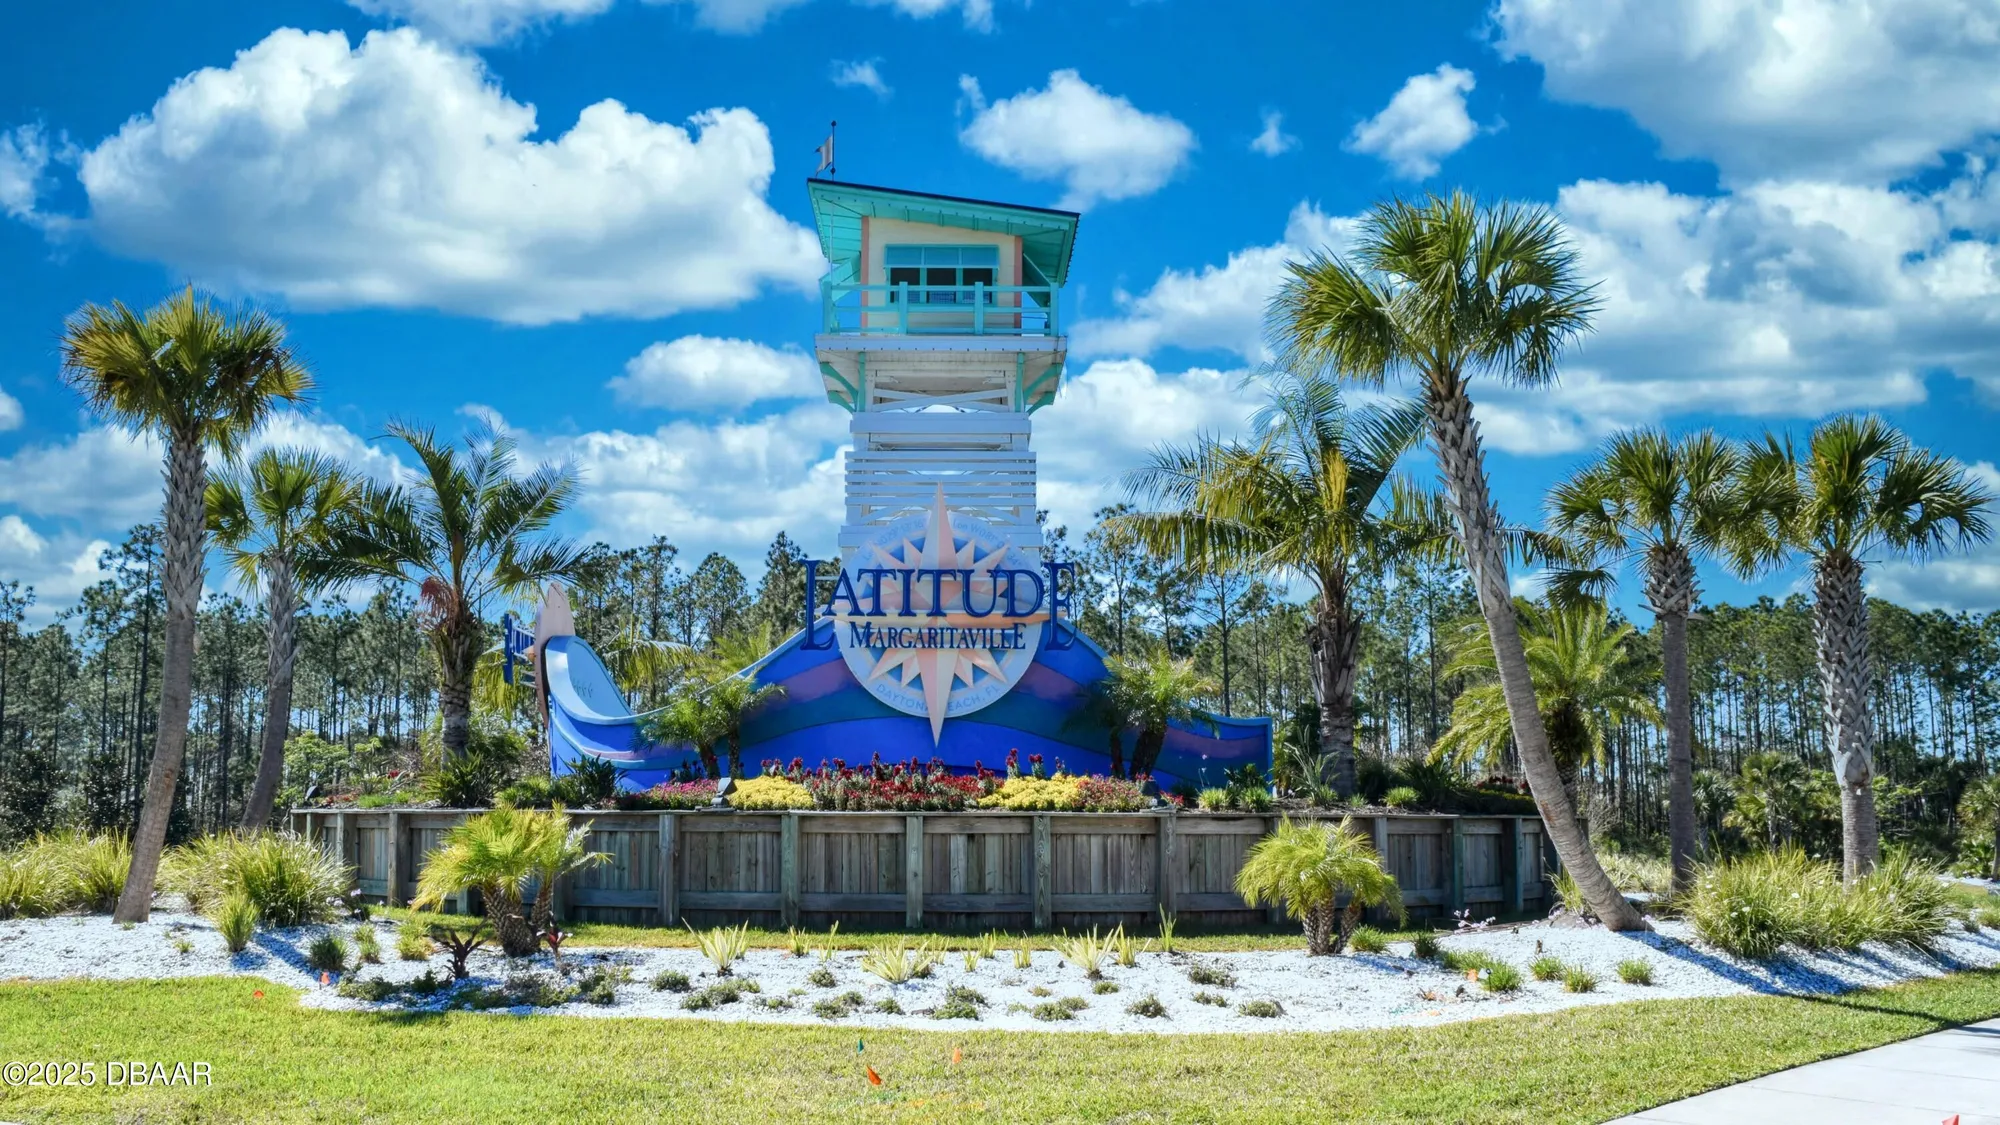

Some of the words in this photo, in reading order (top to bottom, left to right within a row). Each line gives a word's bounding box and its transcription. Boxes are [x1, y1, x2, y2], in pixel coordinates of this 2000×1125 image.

[800, 559, 1077, 651] LATITUDE
[849, 621, 1027, 650] MARGARITAVILLE
[947, 696, 986, 712] EACH,
[986, 684, 1000, 697] FL
